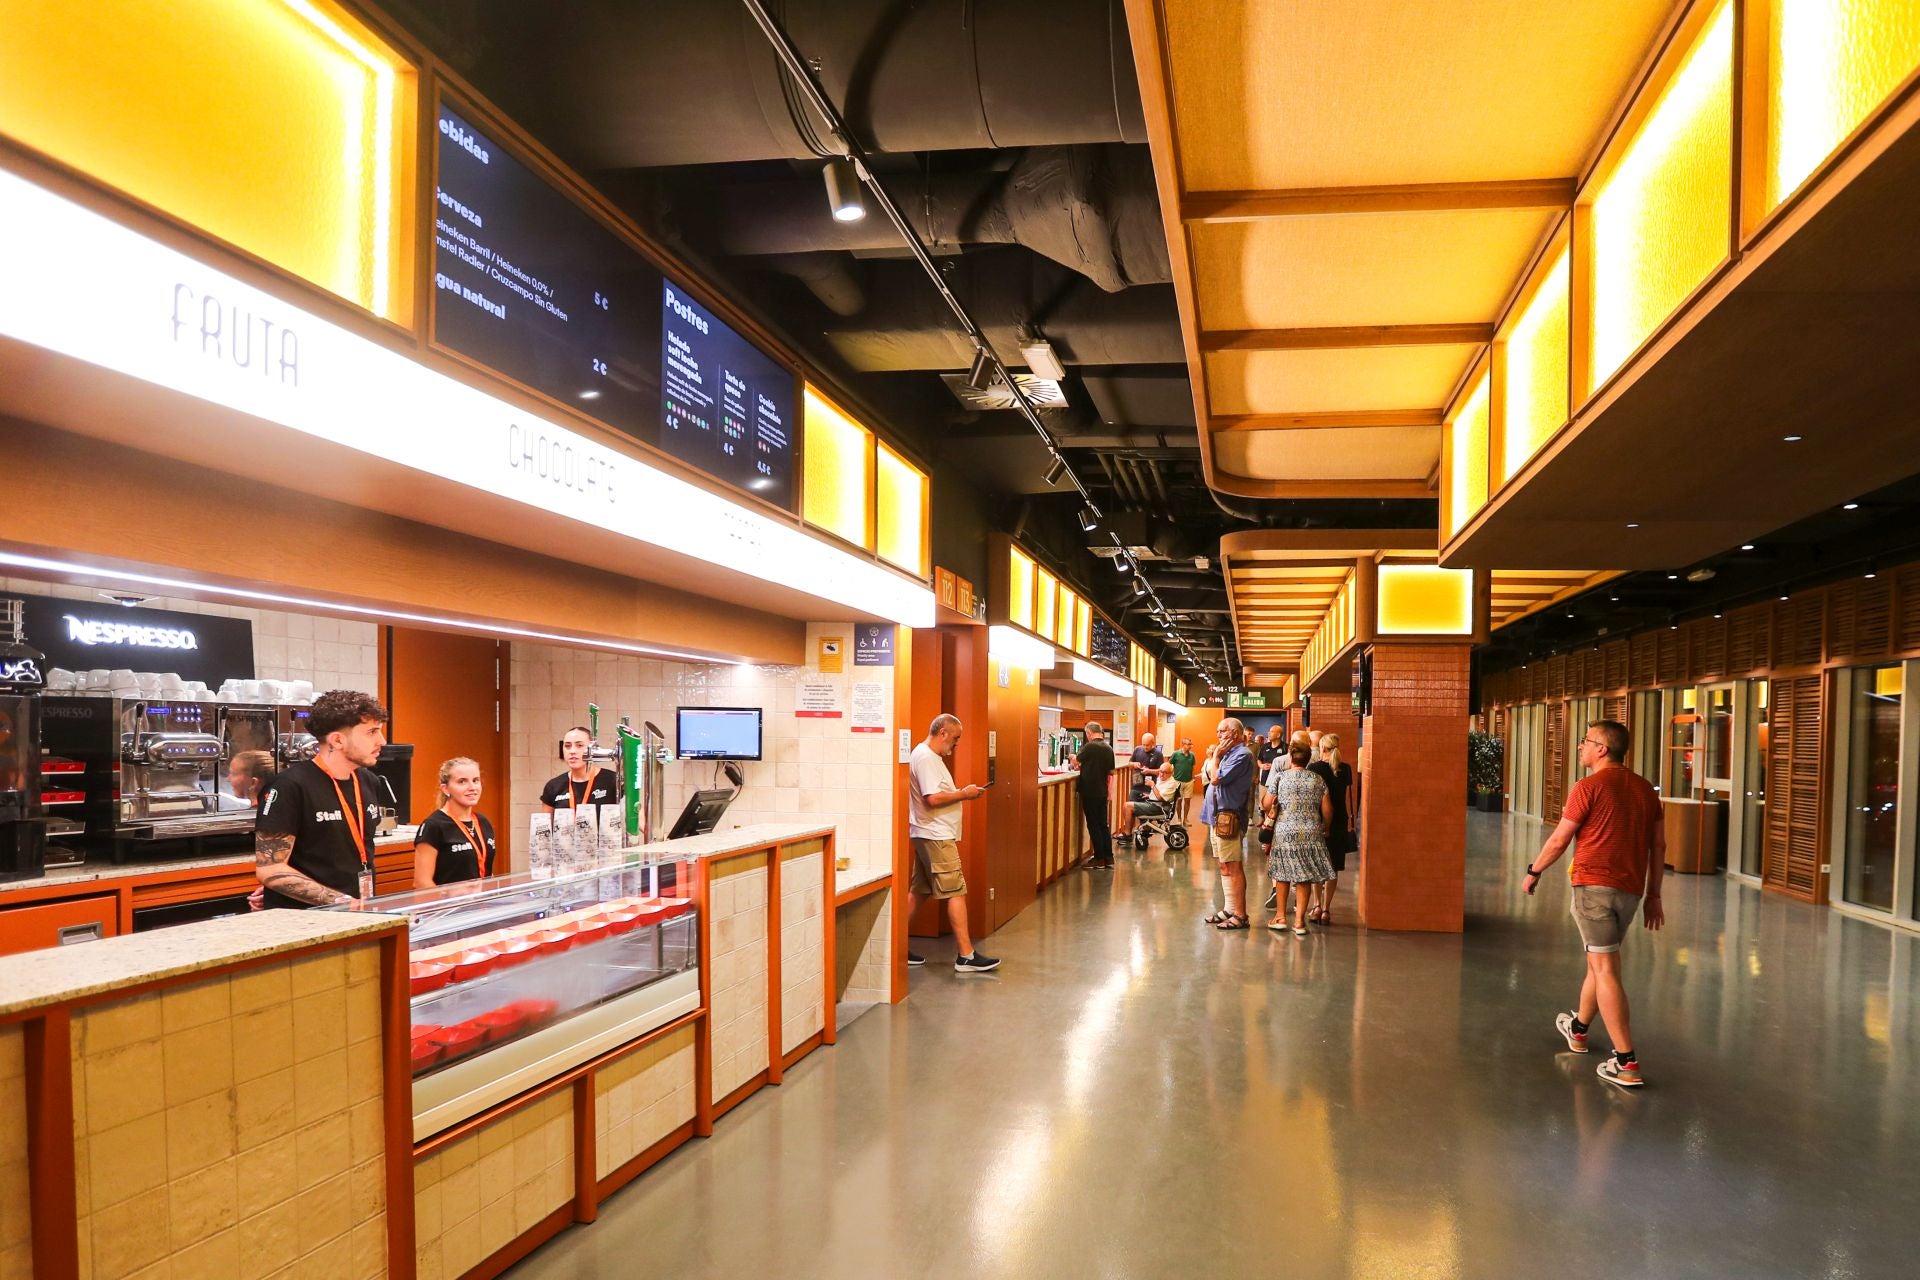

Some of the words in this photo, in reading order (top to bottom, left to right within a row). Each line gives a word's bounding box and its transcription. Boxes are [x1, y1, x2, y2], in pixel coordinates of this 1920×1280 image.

[438, 118, 490, 165] ebidas
[435, 219, 469, 247] eineken
[469, 238, 491, 260] Barril
[496, 254, 531, 285] Heineken
[531, 277, 549, 296] 0,0%
[435, 272, 462, 295] gua
[462, 286, 506, 320] natural
[458, 247, 485, 272] Radler
[491, 268, 534, 301] Cruzcampo
[534, 293, 546, 309] Sin
[545, 301, 568, 322] Gluten
[594, 291, 601, 305] 5
[601, 297, 609, 311] €
[665, 287, 709, 335] Postres
[171, 282, 298, 388] FRUTA
[667, 330, 691, 354] Helado
[592, 358, 600, 372] 2
[600, 362, 608, 376] €
[942, 579, 953, 606] 112
[62, 614, 198, 650] NESPRESSO
[41, 706, 93, 719] ESPRESSO
[315, 810, 343, 822] Staff
